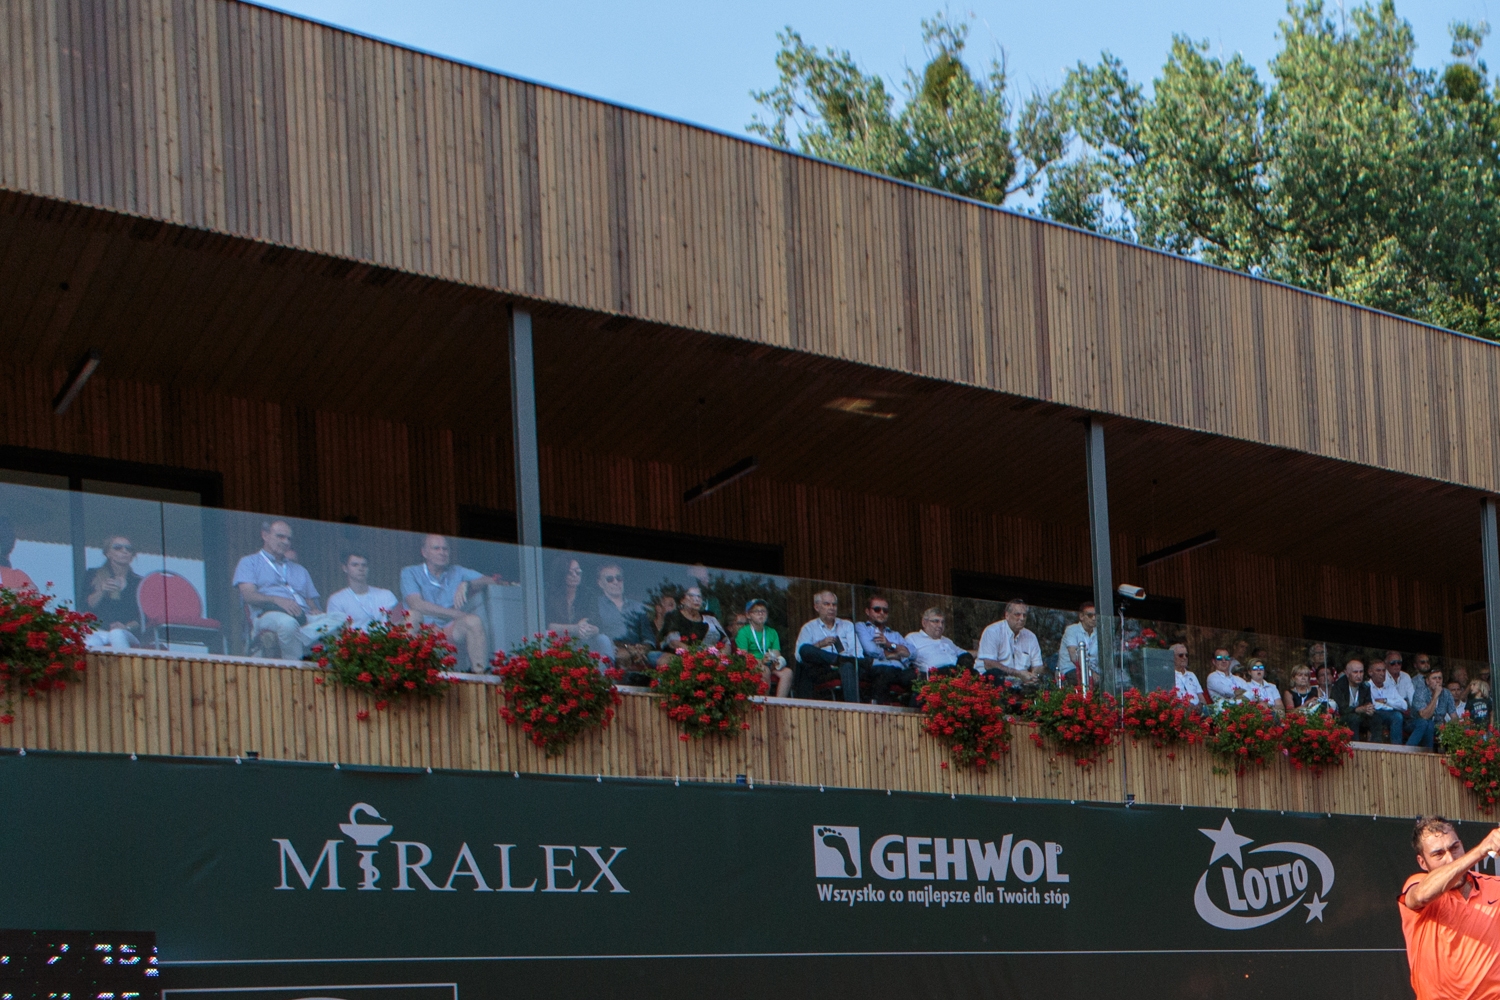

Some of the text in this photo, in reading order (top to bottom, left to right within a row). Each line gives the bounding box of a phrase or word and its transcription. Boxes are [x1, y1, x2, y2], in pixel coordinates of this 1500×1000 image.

[272, 838, 631, 893] MIRALEX
[1221, 859, 1309, 911] LOTTO
[817, 883, 1070, 909] Wszystko co najlepsze dla Twoich stóp
